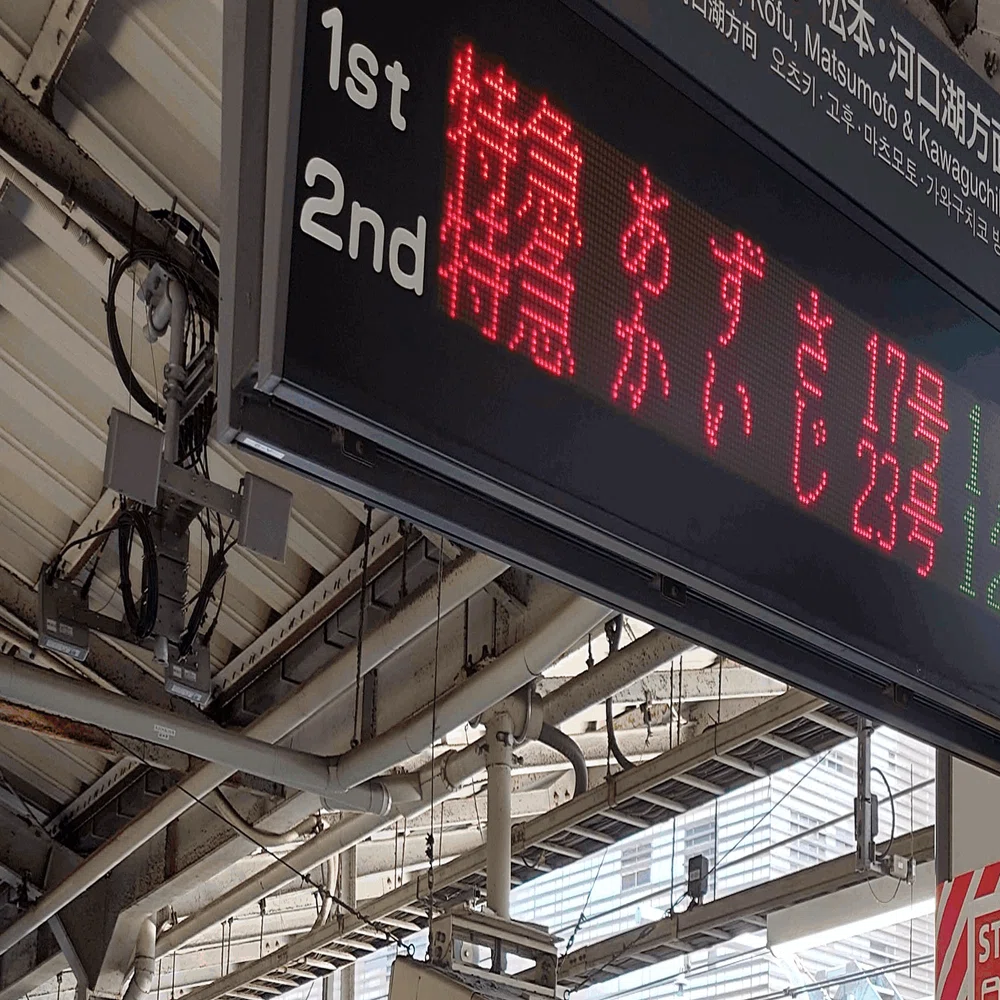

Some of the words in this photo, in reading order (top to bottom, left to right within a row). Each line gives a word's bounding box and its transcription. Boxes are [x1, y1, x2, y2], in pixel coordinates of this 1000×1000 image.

[321, 6, 411, 131] 1st
[805, 23, 898, 130] Matsumoto
[903, 110, 914, 145] &
[300, 157, 426, 296] 2nd
[447, 42, 583, 248] 特急
[620, 165, 834, 398] あずさ
[863, 332, 950, 473] 17号
[438, 191, 576, 376] 特急
[611, 289, 829, 506] かいじ
[853, 436, 944, 578] 23号
